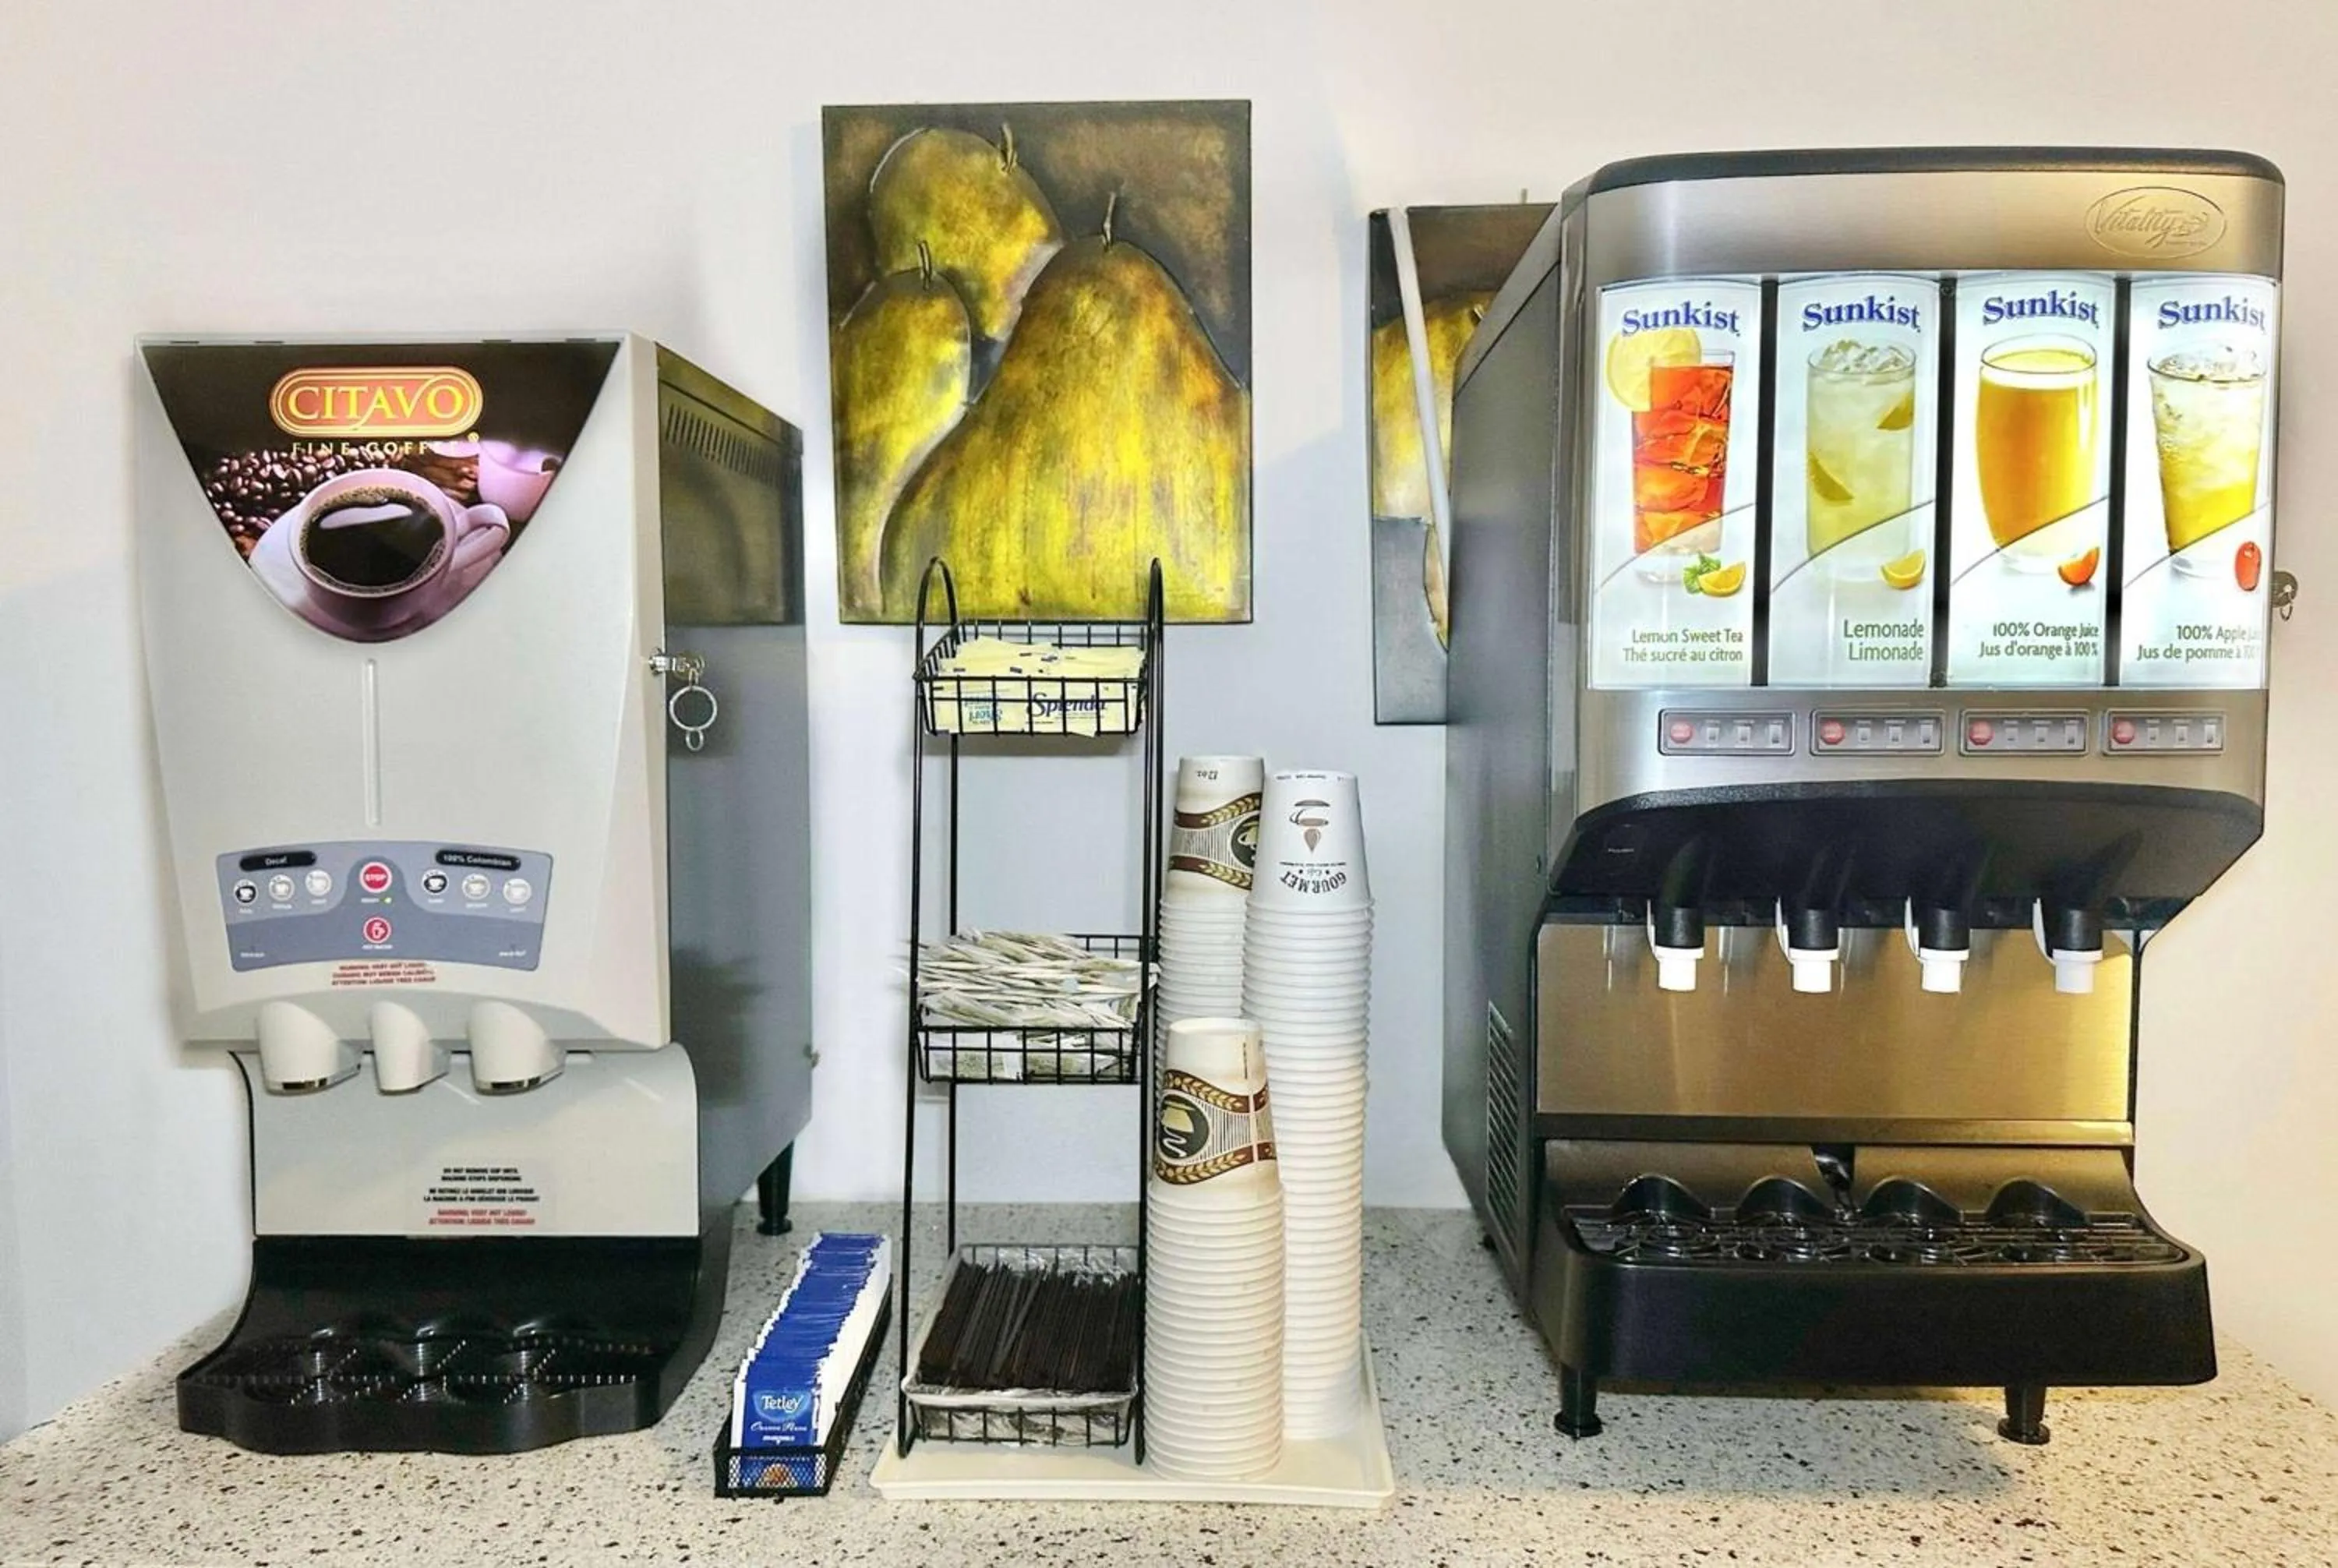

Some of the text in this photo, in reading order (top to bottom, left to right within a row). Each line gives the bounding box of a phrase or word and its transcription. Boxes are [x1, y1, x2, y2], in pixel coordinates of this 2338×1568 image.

[1622, 301, 1741, 337] Sunkist
[1803, 295, 1921, 333] Sunkist
[1983, 290, 2100, 329] Sunkist
[2157, 295, 2266, 334] Sunkist
[286, 383, 465, 423] CITAVO
[292, 440, 461, 455] FINE COFF
[1632, 628, 1743, 644] Lemon Sweet Tea
[1844, 618, 1924, 638] Lemonade
[1993, 622, 2099, 641] 100% Orange Juice
[2176, 625, 2213, 640] 100%
[2216, 626, 2247, 644] Apple
[1623, 647, 1743, 662] Thé sucré au citron
[1849, 641, 1924, 661] Limonade
[1979, 641, 2001, 658] Jus
[2004, 640, 2063, 660] d'orange
[2064, 641, 2071, 656] à
[2137, 644, 2159, 661] Jus
[2163, 643, 2182, 659] de
[2185, 648, 2233, 663] pomme
[365, 873, 387, 881] STOP
[1280, 871, 1347, 894] GOURMET
[761, 1394, 804, 1413] Tetley
